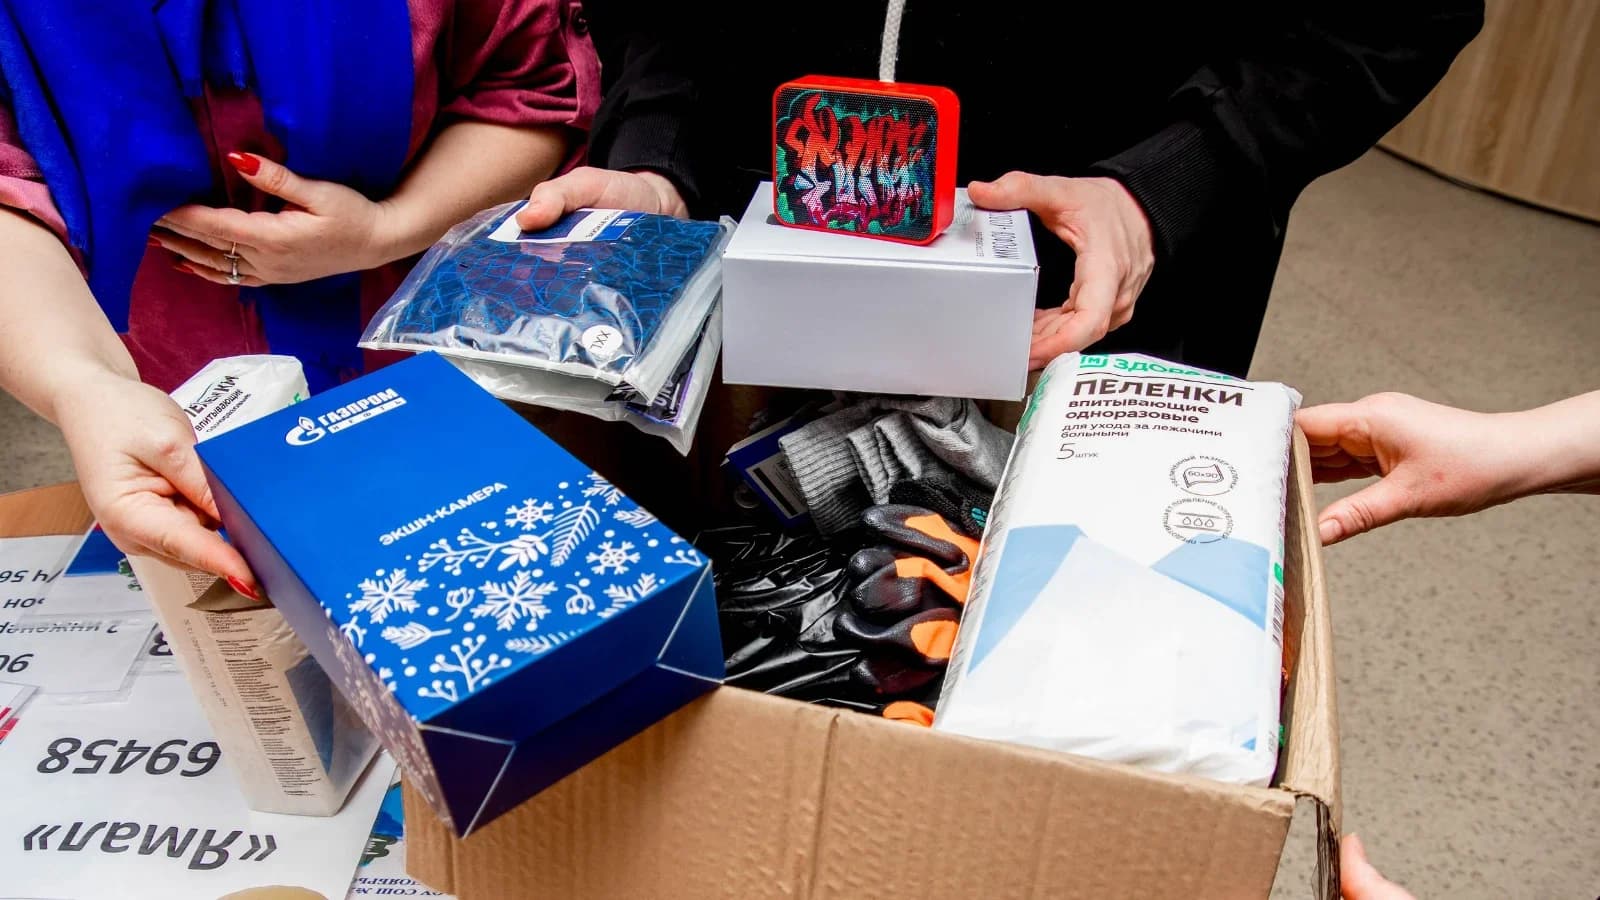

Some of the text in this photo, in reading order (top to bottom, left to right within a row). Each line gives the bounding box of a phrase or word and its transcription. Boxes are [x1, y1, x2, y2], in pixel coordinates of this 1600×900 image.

[590, 330, 612, 350] XXL
[1072, 377, 1243, 407] ПЕЛЕНКИ
[318, 387, 399, 426] ГАЗПРОМ
[332, 398, 405, 432] НЕФТЬ
[1065, 409, 1199, 423] одноразовые
[1068, 399, 1209, 414] впитывающие
[1060, 431, 1130, 439] больными
[1062, 423, 1087, 432] для
[1090, 422, 1131, 430] ухода
[1152, 424, 1223, 437] лежачими
[1056, 443, 1076, 460] 5
[379, 481, 509, 546] ЭКШН-КАМЕРА
[37, 737, 222, 777] 69458
[23, 821, 278, 871] «Ямал»
[375, 887, 417, 895] СОШ
